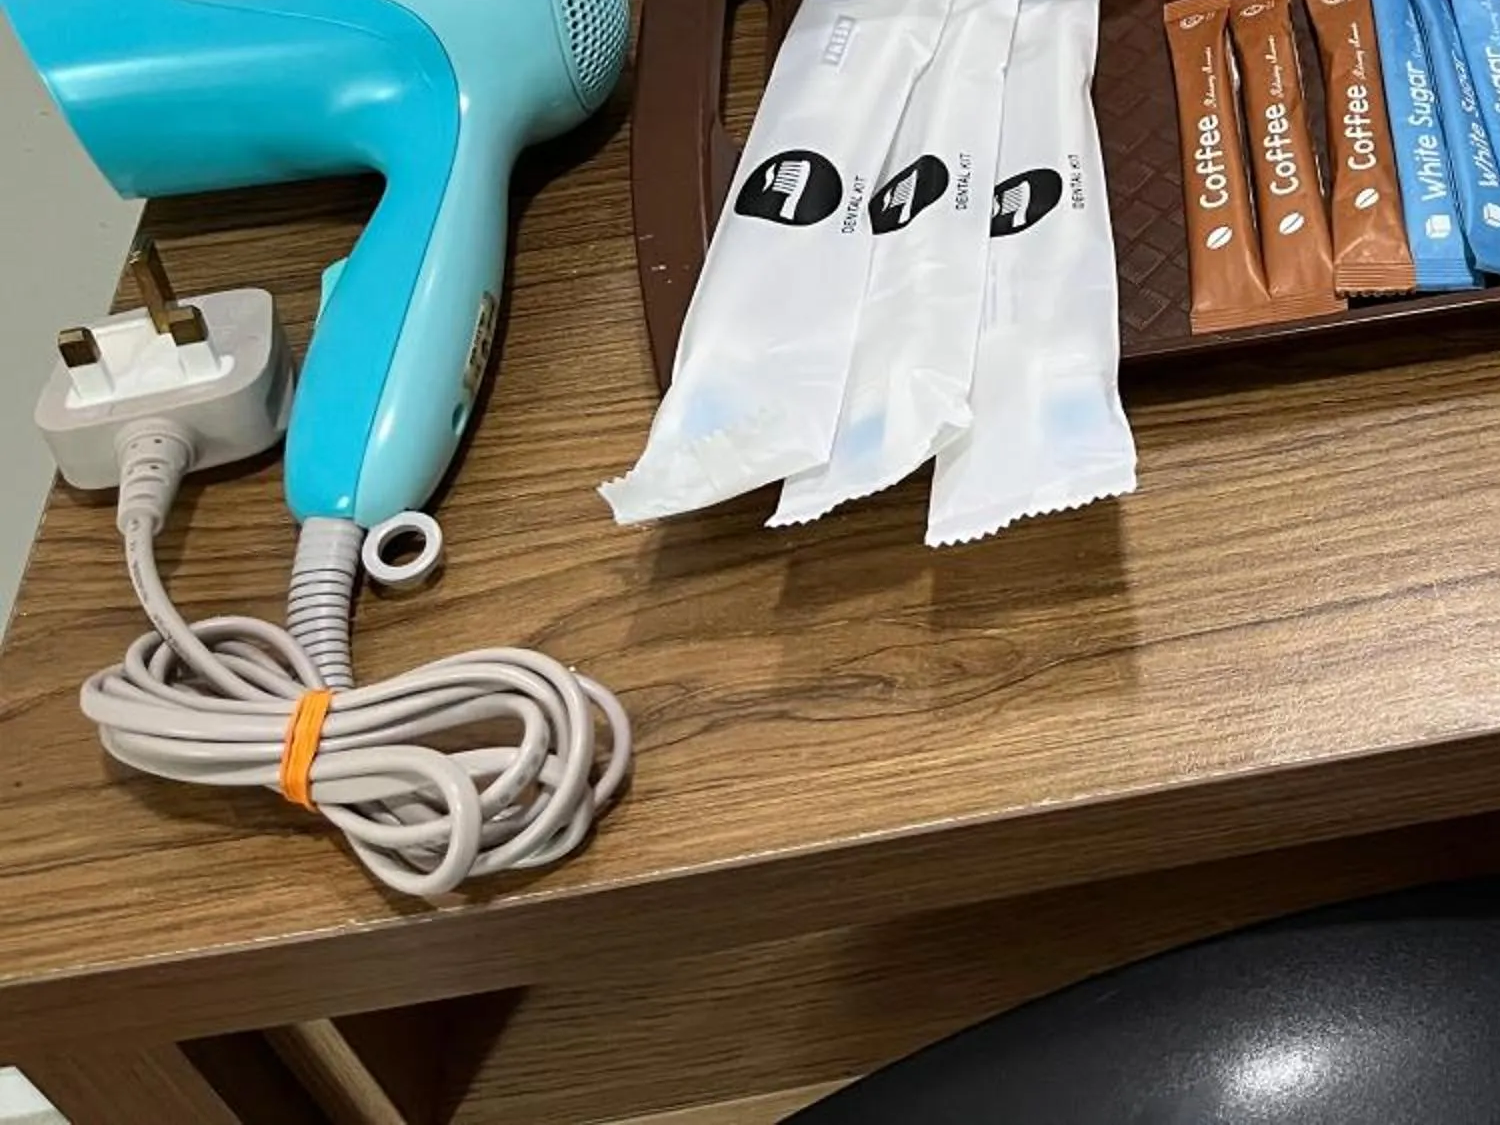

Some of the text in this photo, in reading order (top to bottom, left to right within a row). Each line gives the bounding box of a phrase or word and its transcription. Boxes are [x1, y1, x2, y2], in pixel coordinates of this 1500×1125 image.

[1343, 84, 1377, 171] Coffee
[1407, 61, 1435, 128] Sugar
[955, 153, 973, 211] DENTAL KIT
[1068, 154, 1085, 210] DENTAL KIT
[1194, 114, 1229, 209] Coffee
[1263, 103, 1300, 195] Coffee
[1415, 134, 1447, 202] White
[1469, 122, 1499, 188] White
[841, 176, 866, 234] DENTAL KIT
